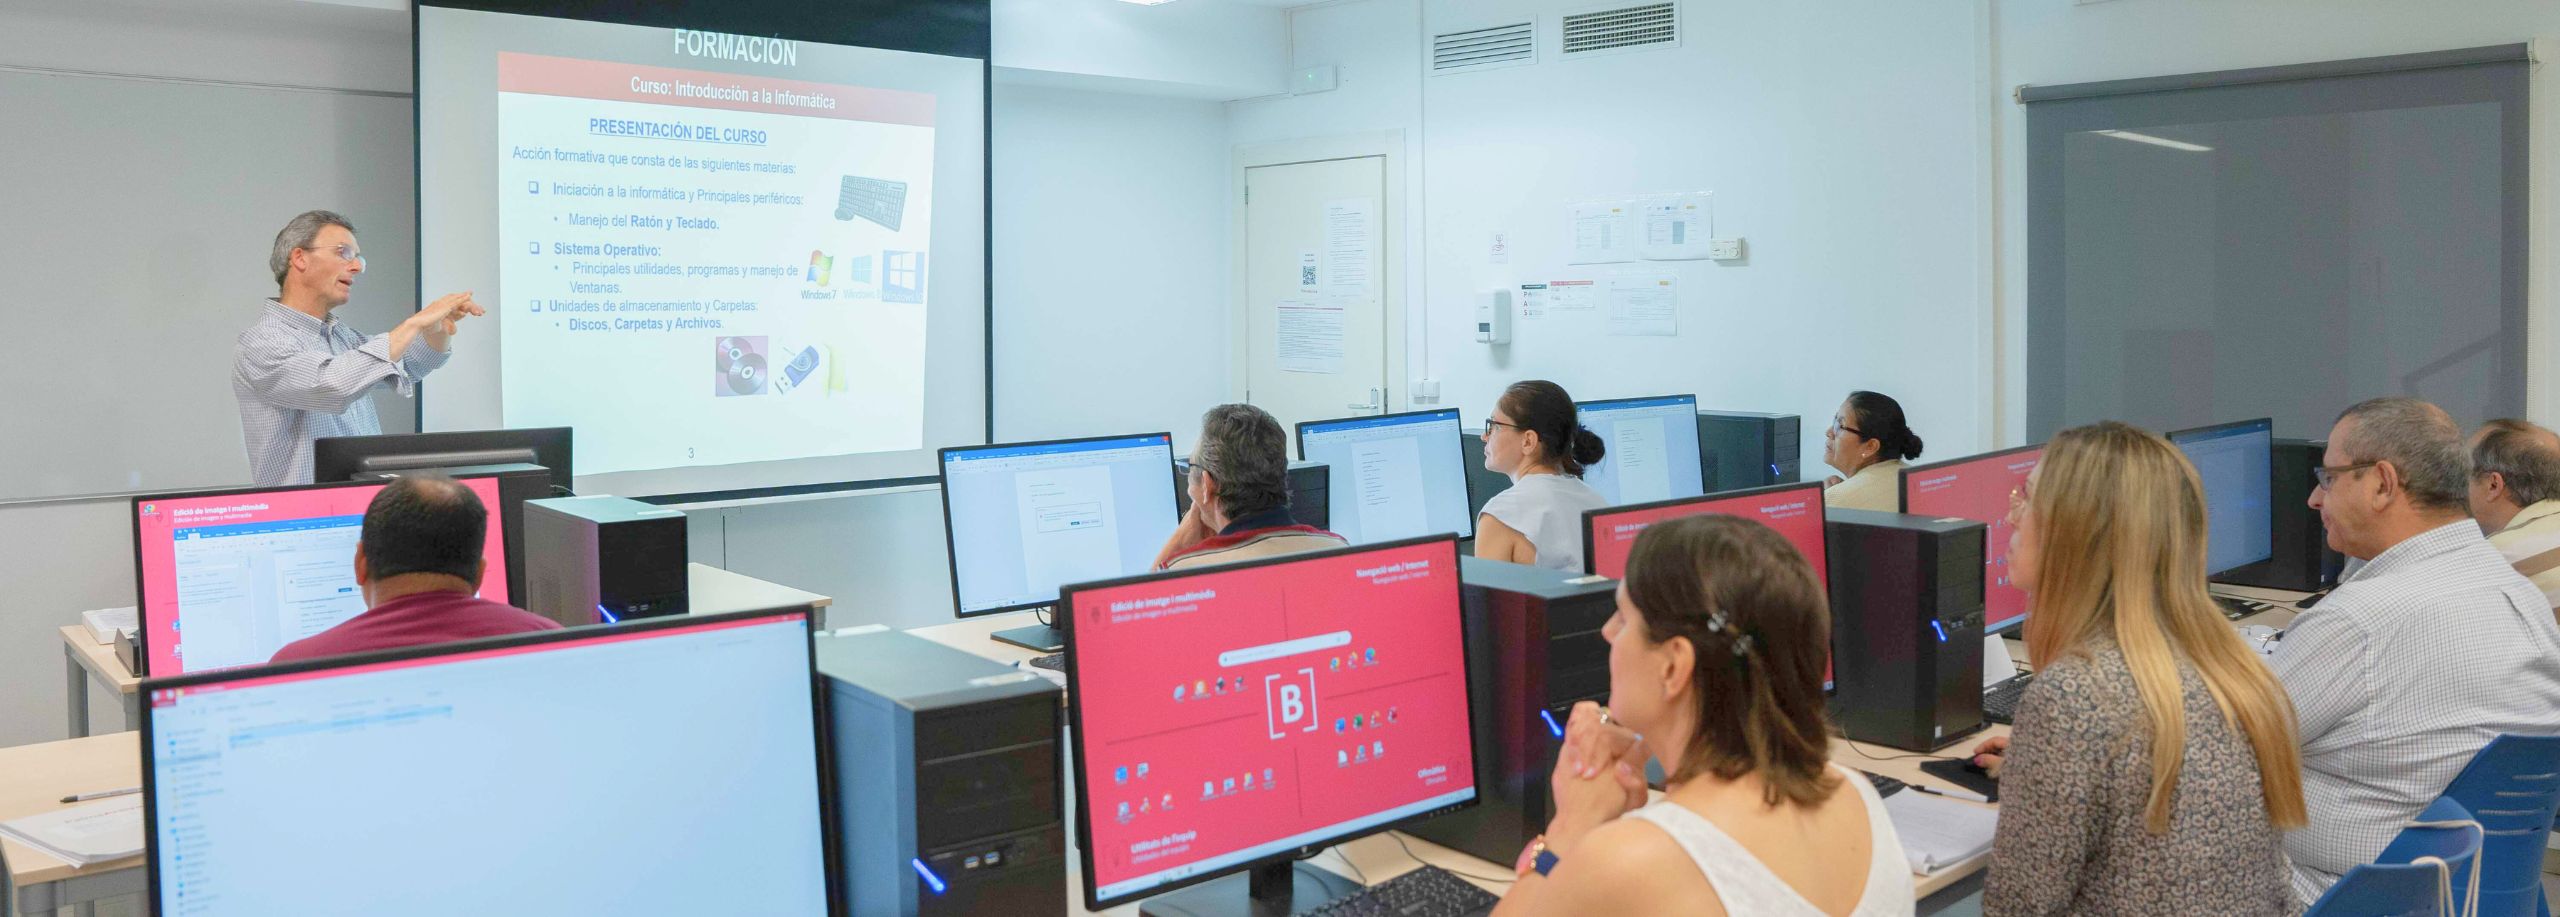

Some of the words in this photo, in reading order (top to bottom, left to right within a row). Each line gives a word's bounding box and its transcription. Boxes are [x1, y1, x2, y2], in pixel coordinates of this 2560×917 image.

[674, 27, 797, 67] FORMACIÓN
[631, 76, 672, 96] Curso:
[675, 80, 749, 102] Introducción
[752, 91, 759, 102] a
[762, 87, 772, 104] la
[775, 88, 836, 110] Informática
[589, 117, 692, 140] PRESENTACIÓN
[696, 126, 720, 142] DEL
[723, 128, 767, 144] CURSO
[513, 146, 551, 161] Acción
[555, 147, 605, 164] formativa
[608, 154, 628, 167] que
[631, 155, 665, 167] consta
[668, 156, 681, 168] de
[685, 156, 698, 169] las
[701, 157, 750, 173] siguientes
[553, 181, 604, 197] Iniciación
[607, 188, 614, 198] a
[617, 184, 626, 198] la
[630, 185, 686, 200] informática
[689, 190, 695, 203] y
[697, 188, 751, 205] Principales
[753, 191, 804, 206] periféricos:
[569, 212, 609, 230] Manejo
[611, 214, 628, 227] del
[631, 214, 663, 229] Ratón
[666, 218, 673, 231] y
[676, 215, 720, 230] Teclado.
[554, 242, 600, 256] Sistema
[603, 243, 662, 259] Operativo:
[572, 261, 631, 277] Principales
[634, 262, 685, 277] utilidades,
[687, 265, 739, 278] programas
[742, 266, 748, 279] y
[750, 264, 784, 279] manejo
[786, 264, 799, 277] de
[570, 280, 623, 294] Ventanas.
[549, 299, 600, 312] Unidades
[603, 299, 617, 312] de
[619, 300, 702, 312] almacenamiento
[704, 301, 711, 314] y
[569, 317, 612, 332] Discos,
[614, 317, 663, 333] Carpetas
[666, 318, 673, 333] y
[675, 316, 725, 329] Archivos.
[687, 447, 695, 459] 3
